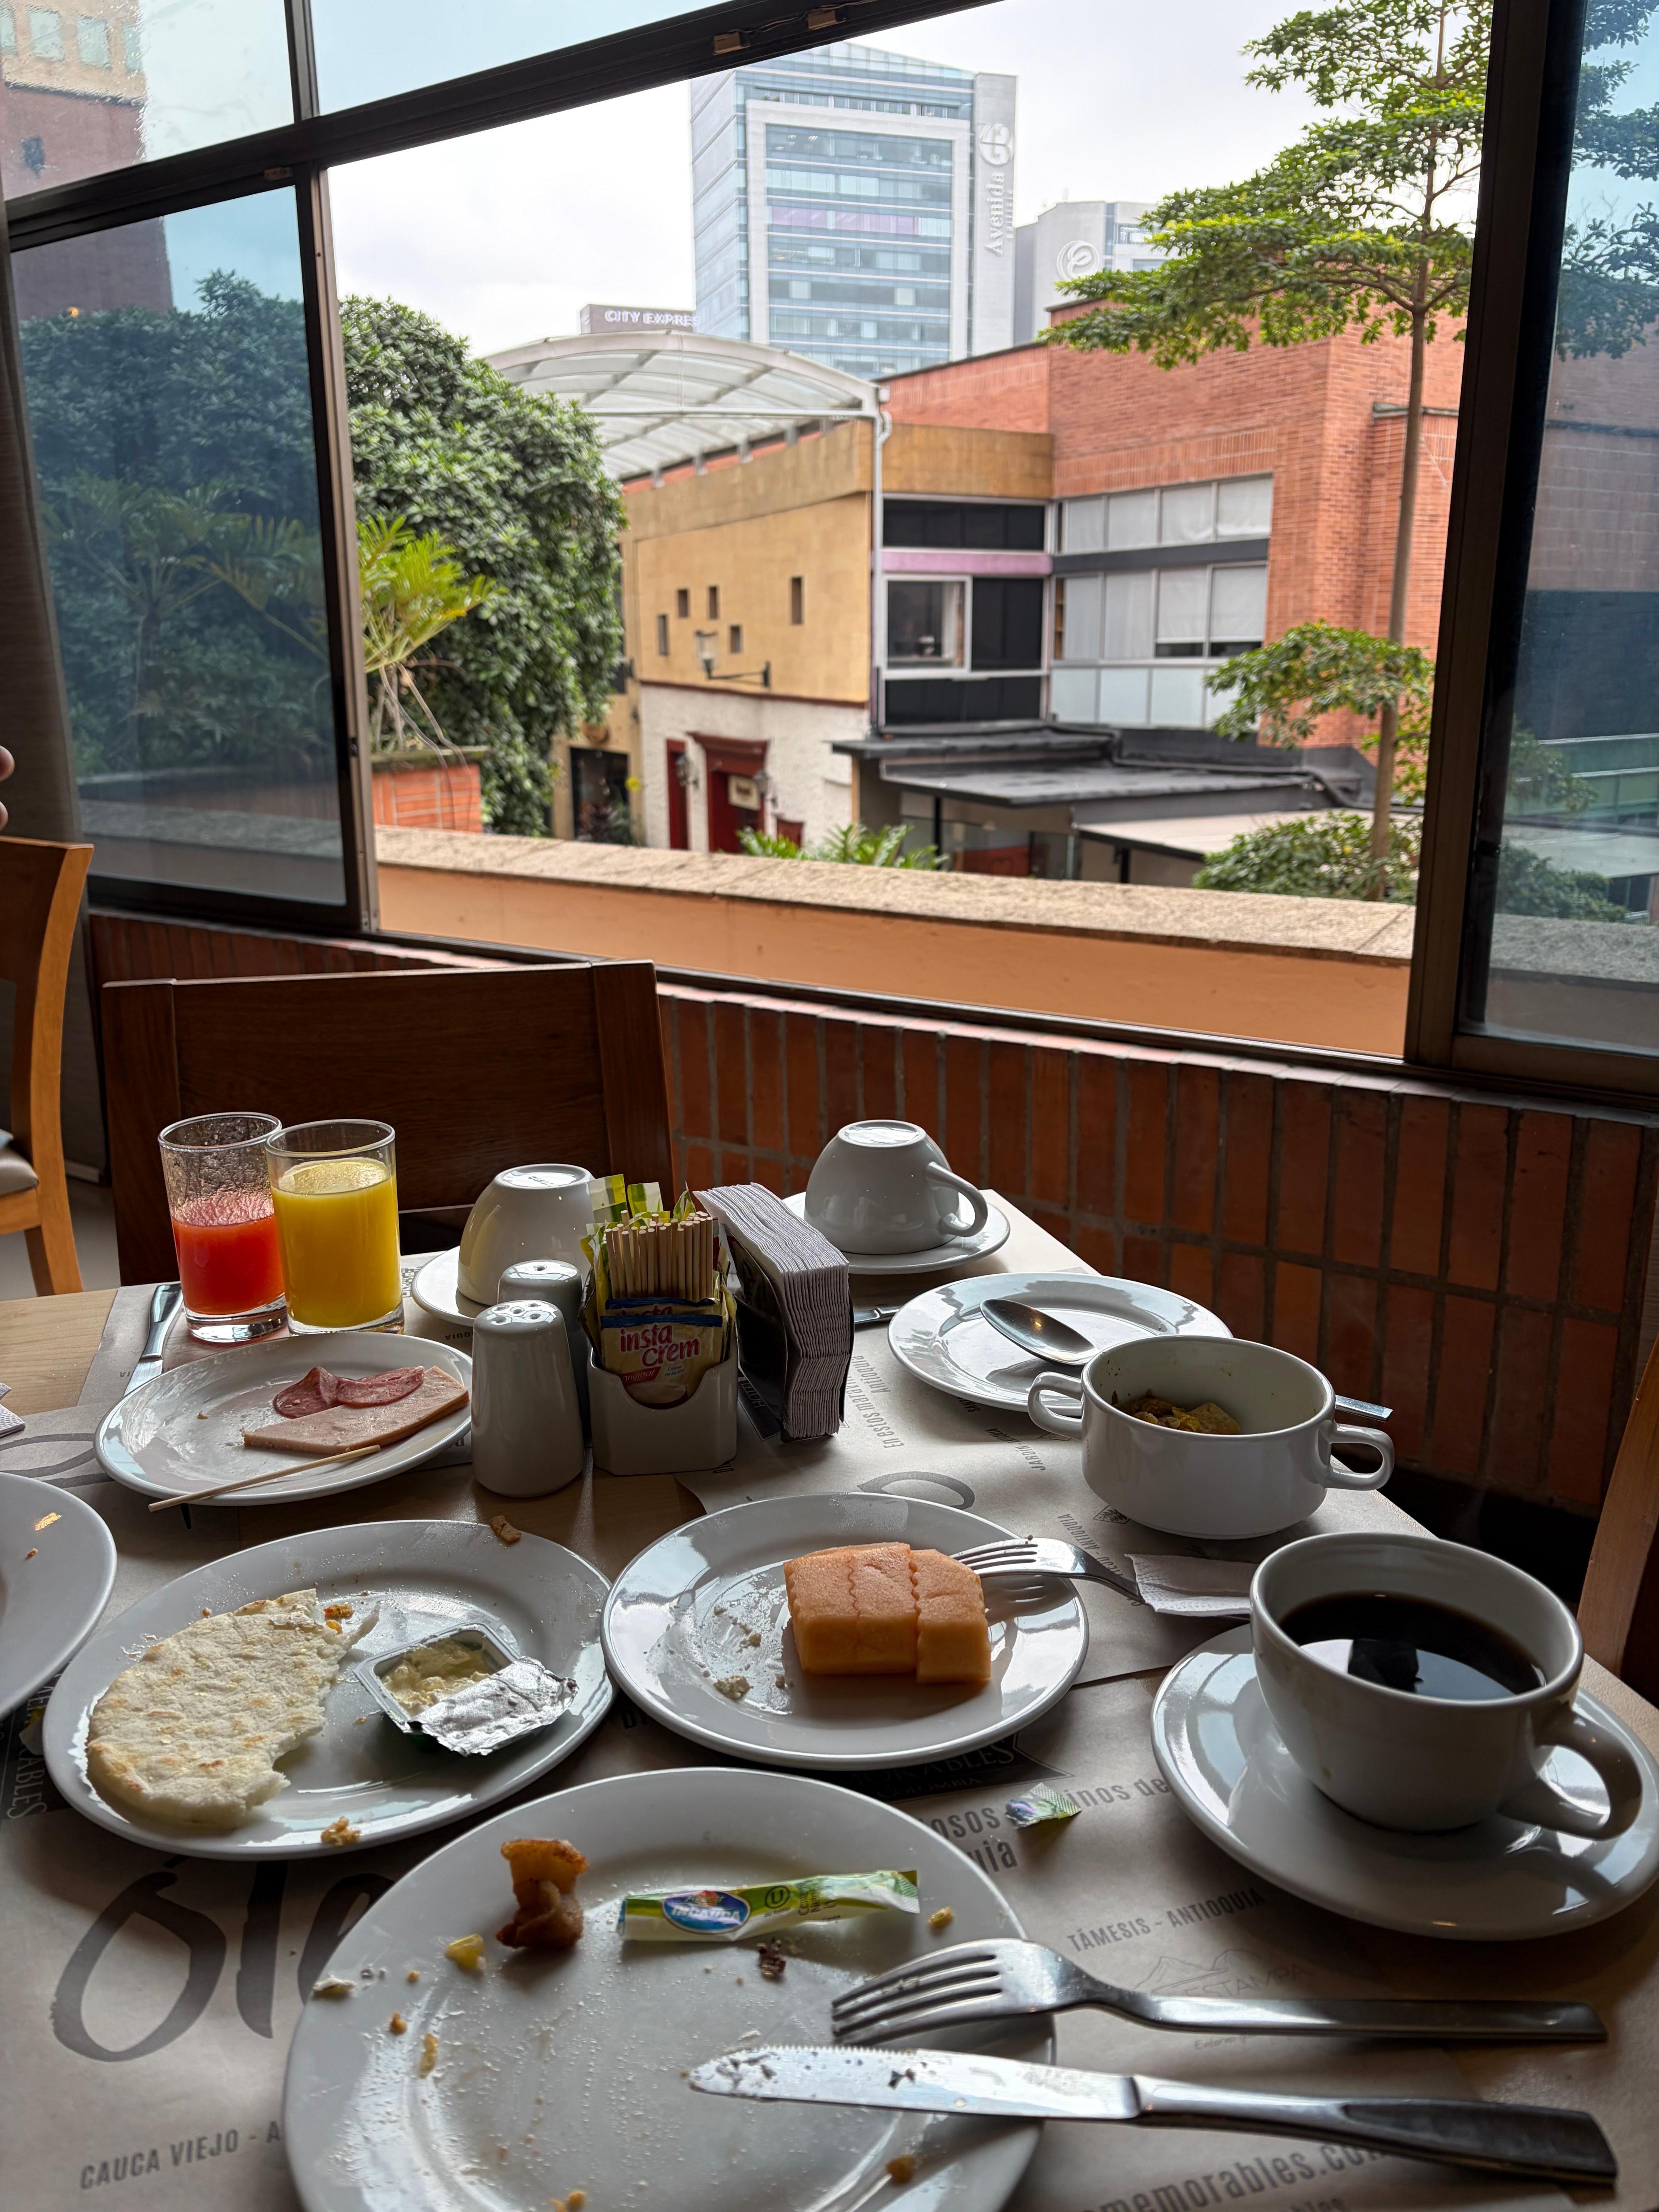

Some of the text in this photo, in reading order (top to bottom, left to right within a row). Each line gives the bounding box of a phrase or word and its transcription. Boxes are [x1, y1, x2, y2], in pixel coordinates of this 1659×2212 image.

[985, 172, 1005, 256] Avenida
[605, 310, 641, 323] CITY
[620, 1324, 672, 1352] insta
[642, 1338, 700, 1367] crem
[851, 1355, 891, 1393] Antioquia
[863, 1412, 895, 1437] estos
[882, 1438, 905, 1448] En
[1057, 1513, 1100, 1550] ANTIOQUIA
[1136, 1778, 1169, 1797] de
[1066, 1918, 1152, 1952] TÁMESIS
[1166, 1887, 1266, 1928] ANTIOQUIA
[80, 2148, 160, 2190] CAUCA
[170, 2128, 239, 2167] VIEJO
